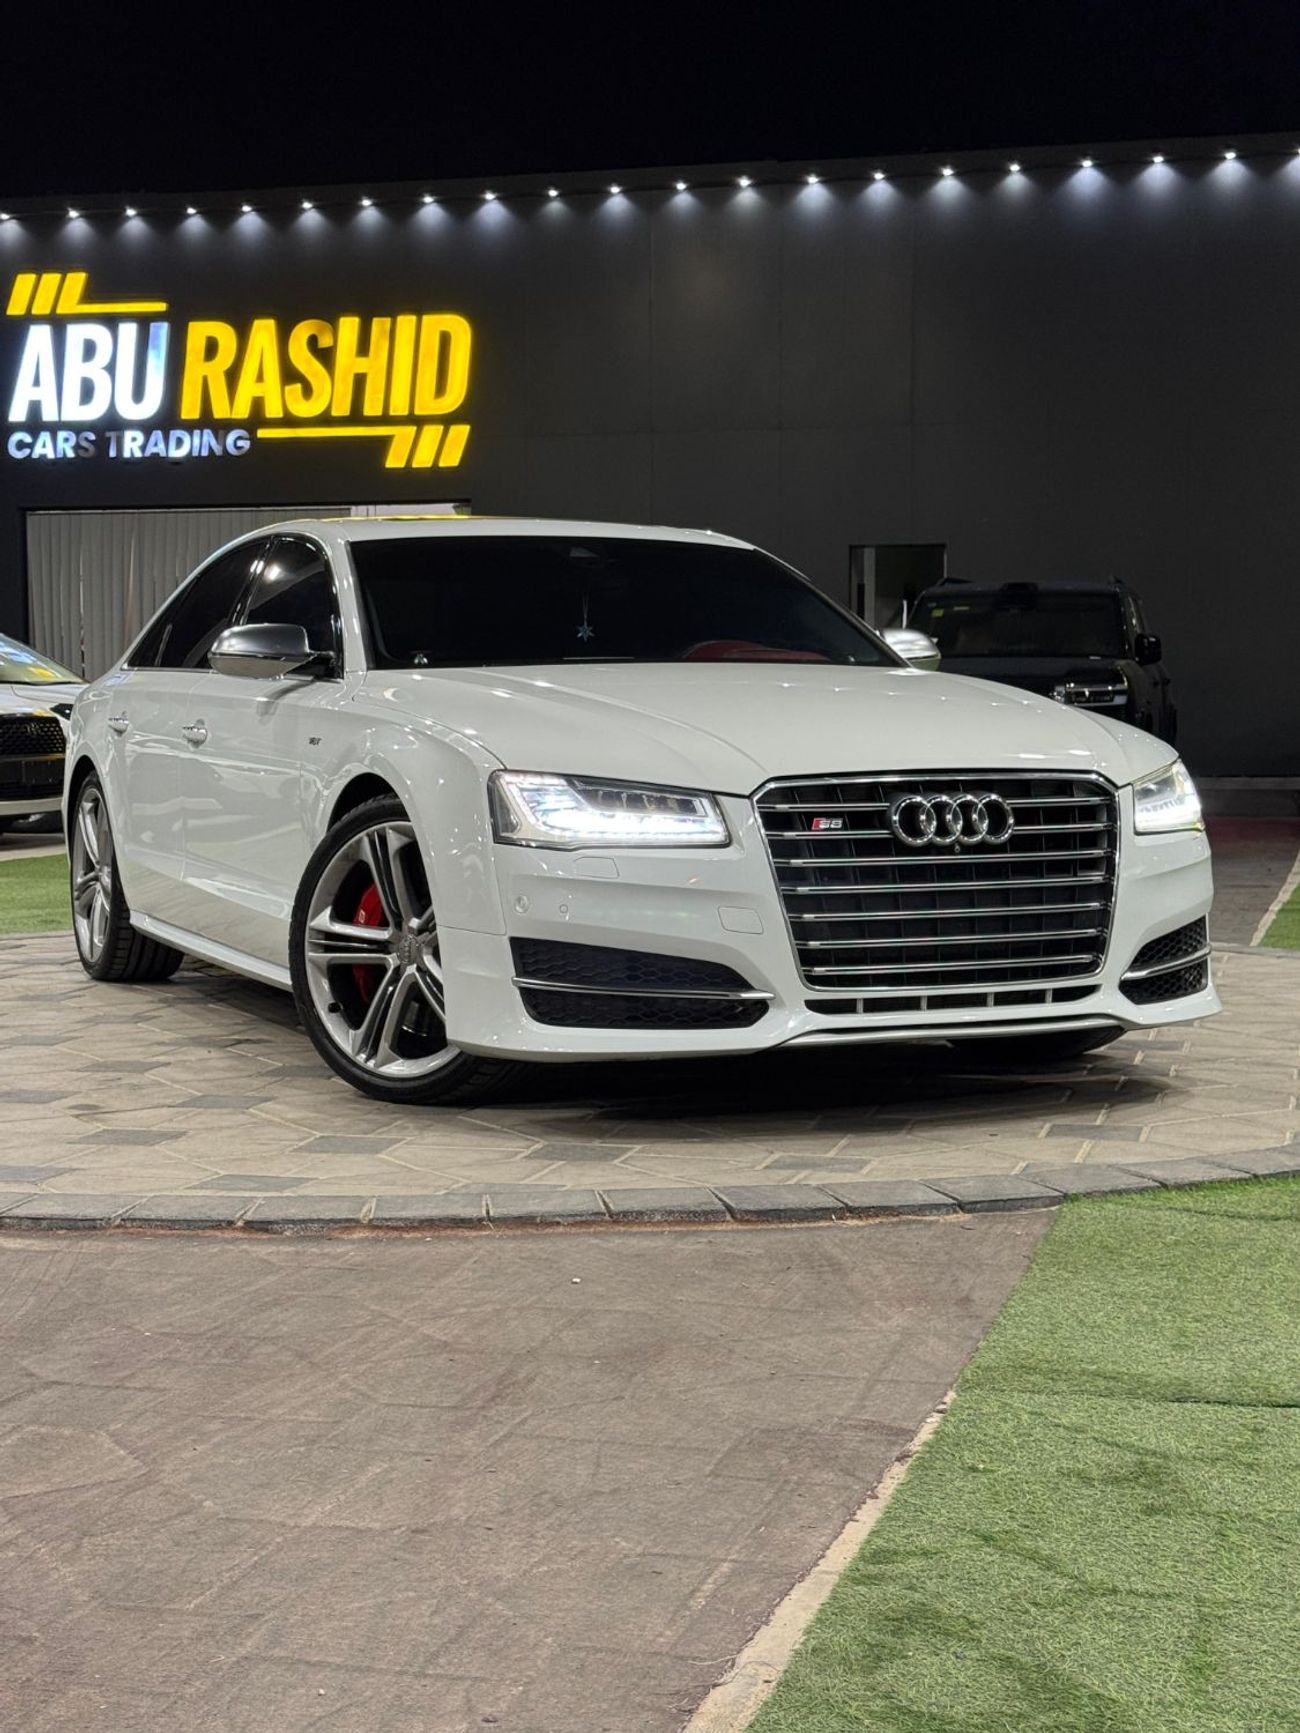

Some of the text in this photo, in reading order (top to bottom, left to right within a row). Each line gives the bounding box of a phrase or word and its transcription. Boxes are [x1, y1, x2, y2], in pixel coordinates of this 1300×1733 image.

[8, 314, 472, 422] ABU RASHID
[7, 428, 251, 460] CARS TRADING
